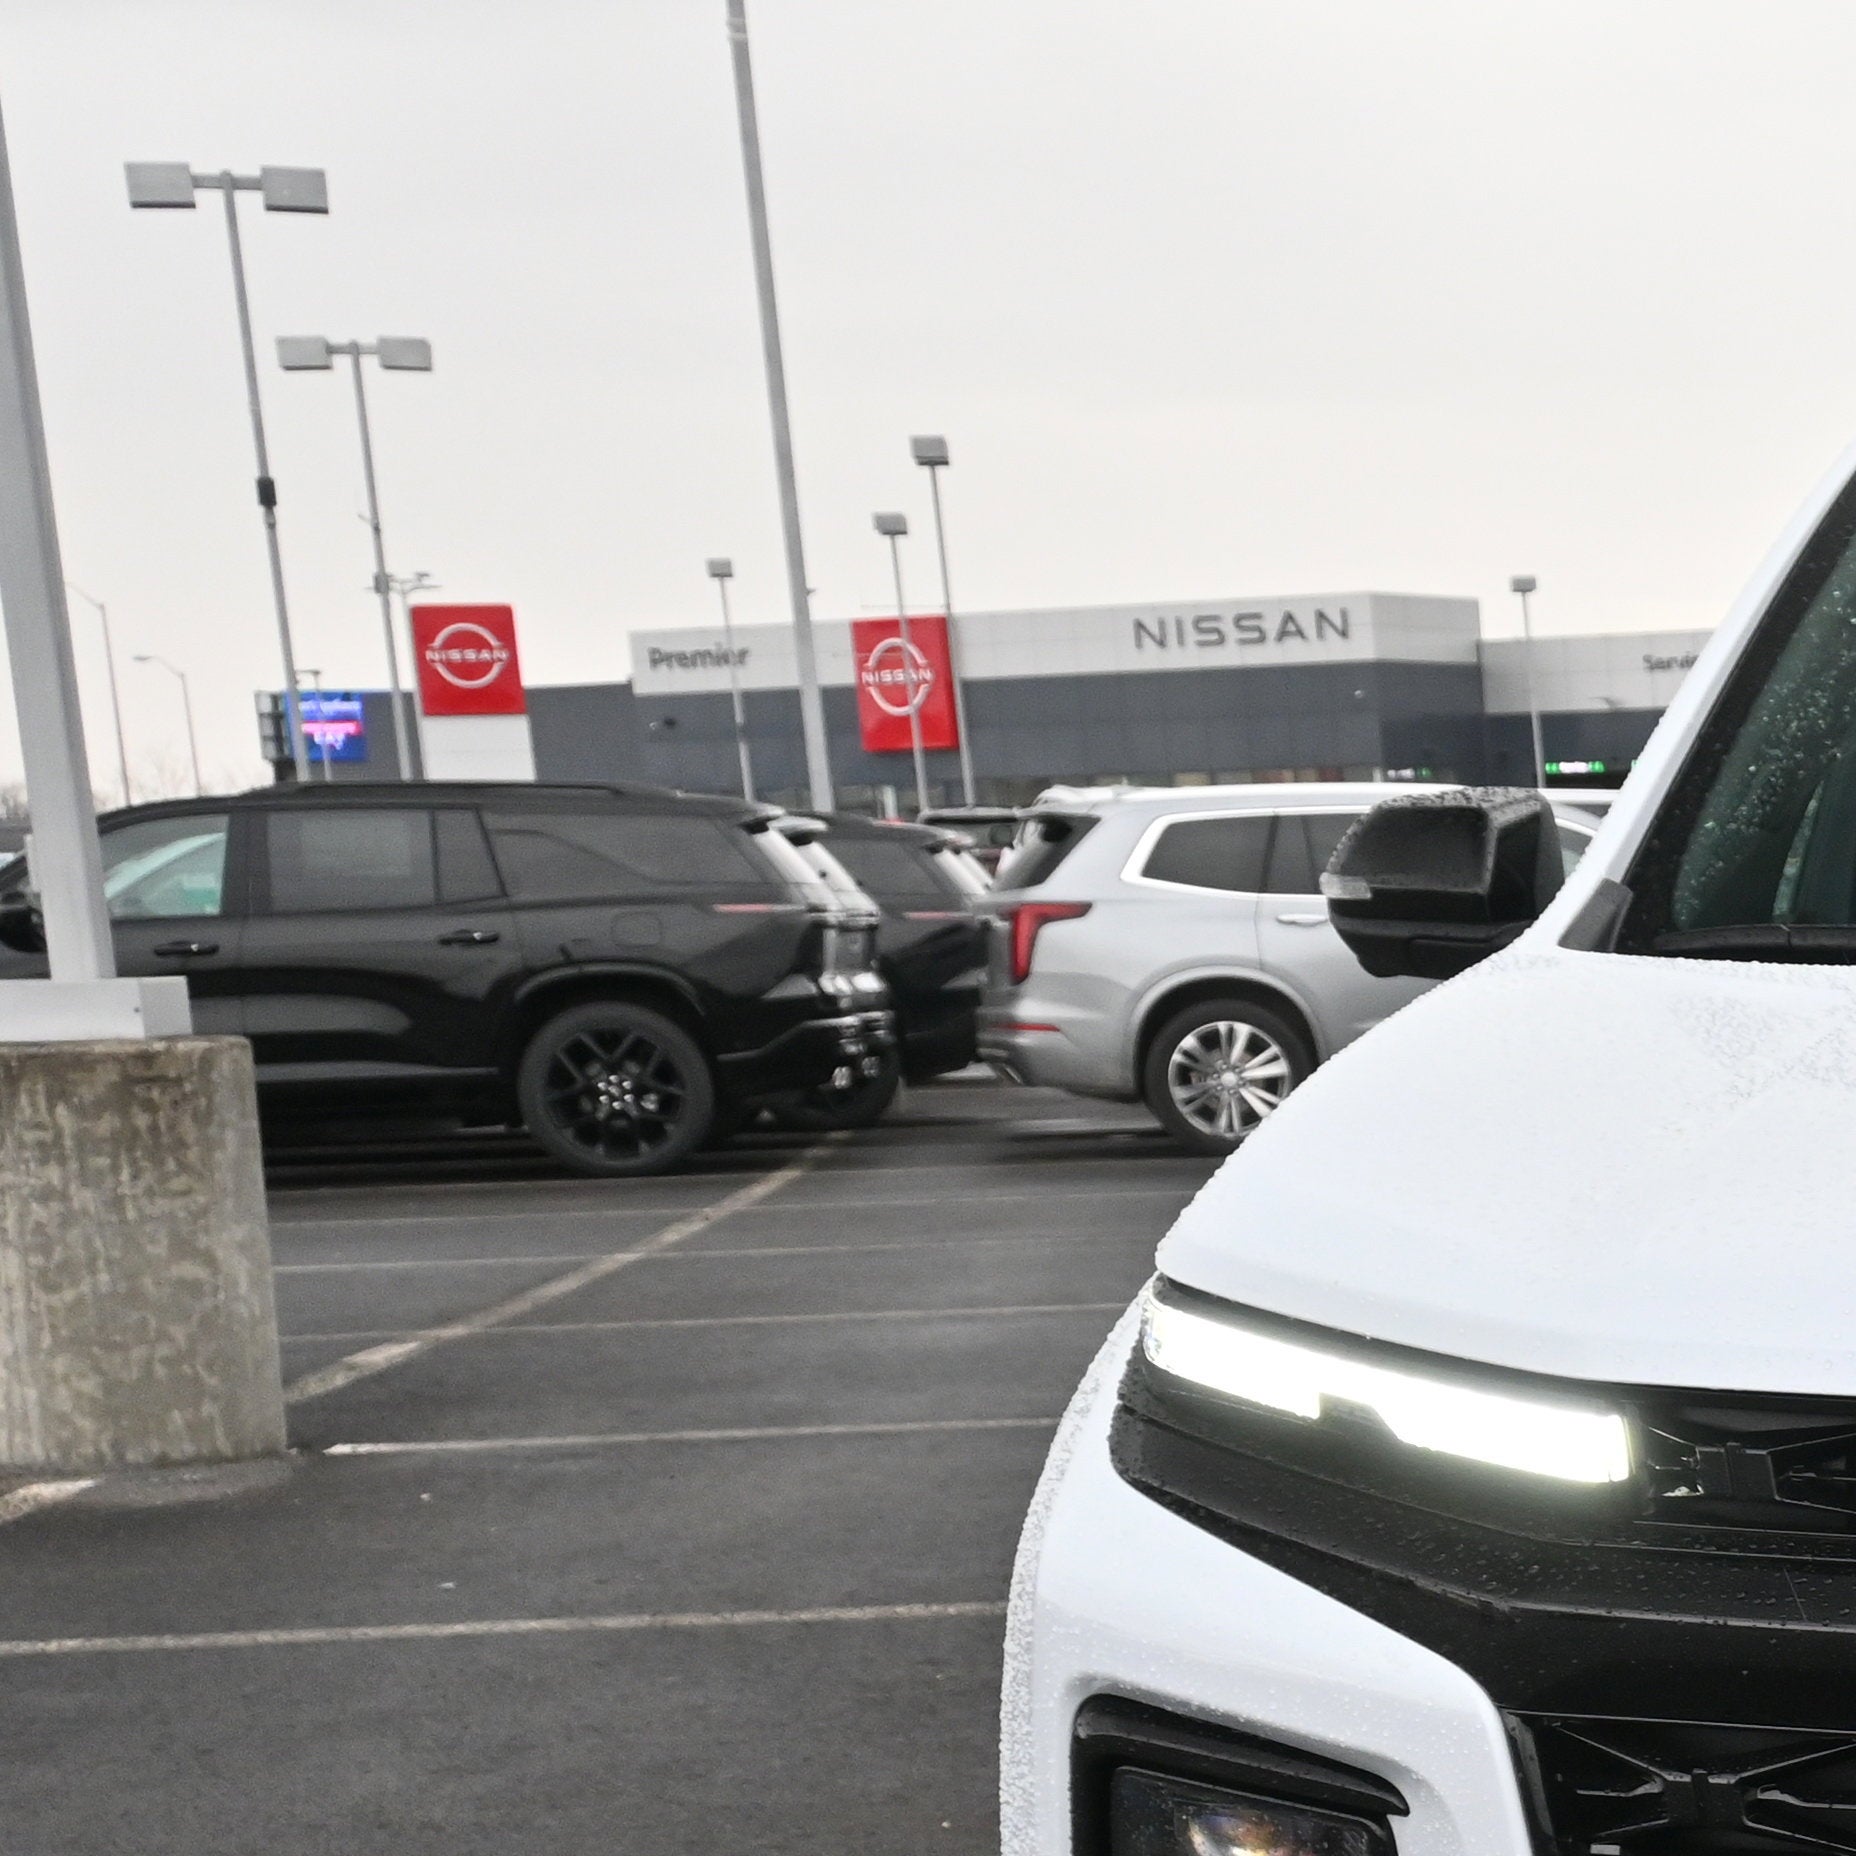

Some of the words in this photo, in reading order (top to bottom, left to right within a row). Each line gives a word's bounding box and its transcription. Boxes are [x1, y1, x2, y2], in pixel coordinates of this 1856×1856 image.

[1132, 607, 1349, 650] NISSAN
[425, 648, 509, 663] NISSAN
[647, 641, 749, 671] Premier
